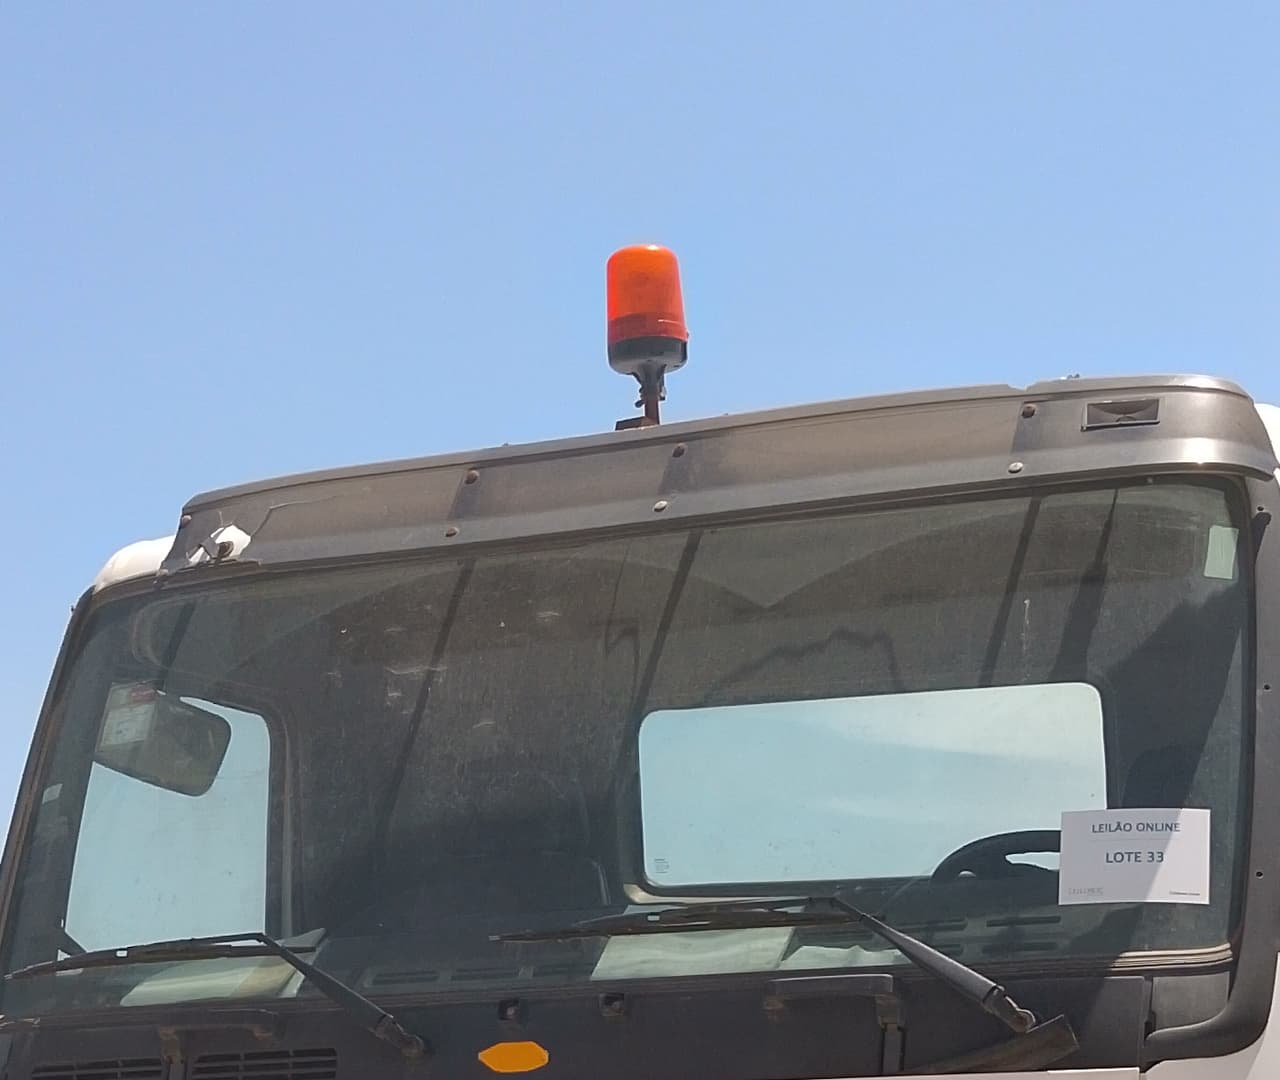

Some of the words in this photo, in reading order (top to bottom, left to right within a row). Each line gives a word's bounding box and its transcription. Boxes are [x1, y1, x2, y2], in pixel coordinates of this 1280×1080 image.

[1091, 821, 1133, 834] LEILÃO
[1136, 822, 1181, 833] ONLINE
[1106, 851, 1142, 864] LOTE
[1146, 851, 1165, 863] 33
